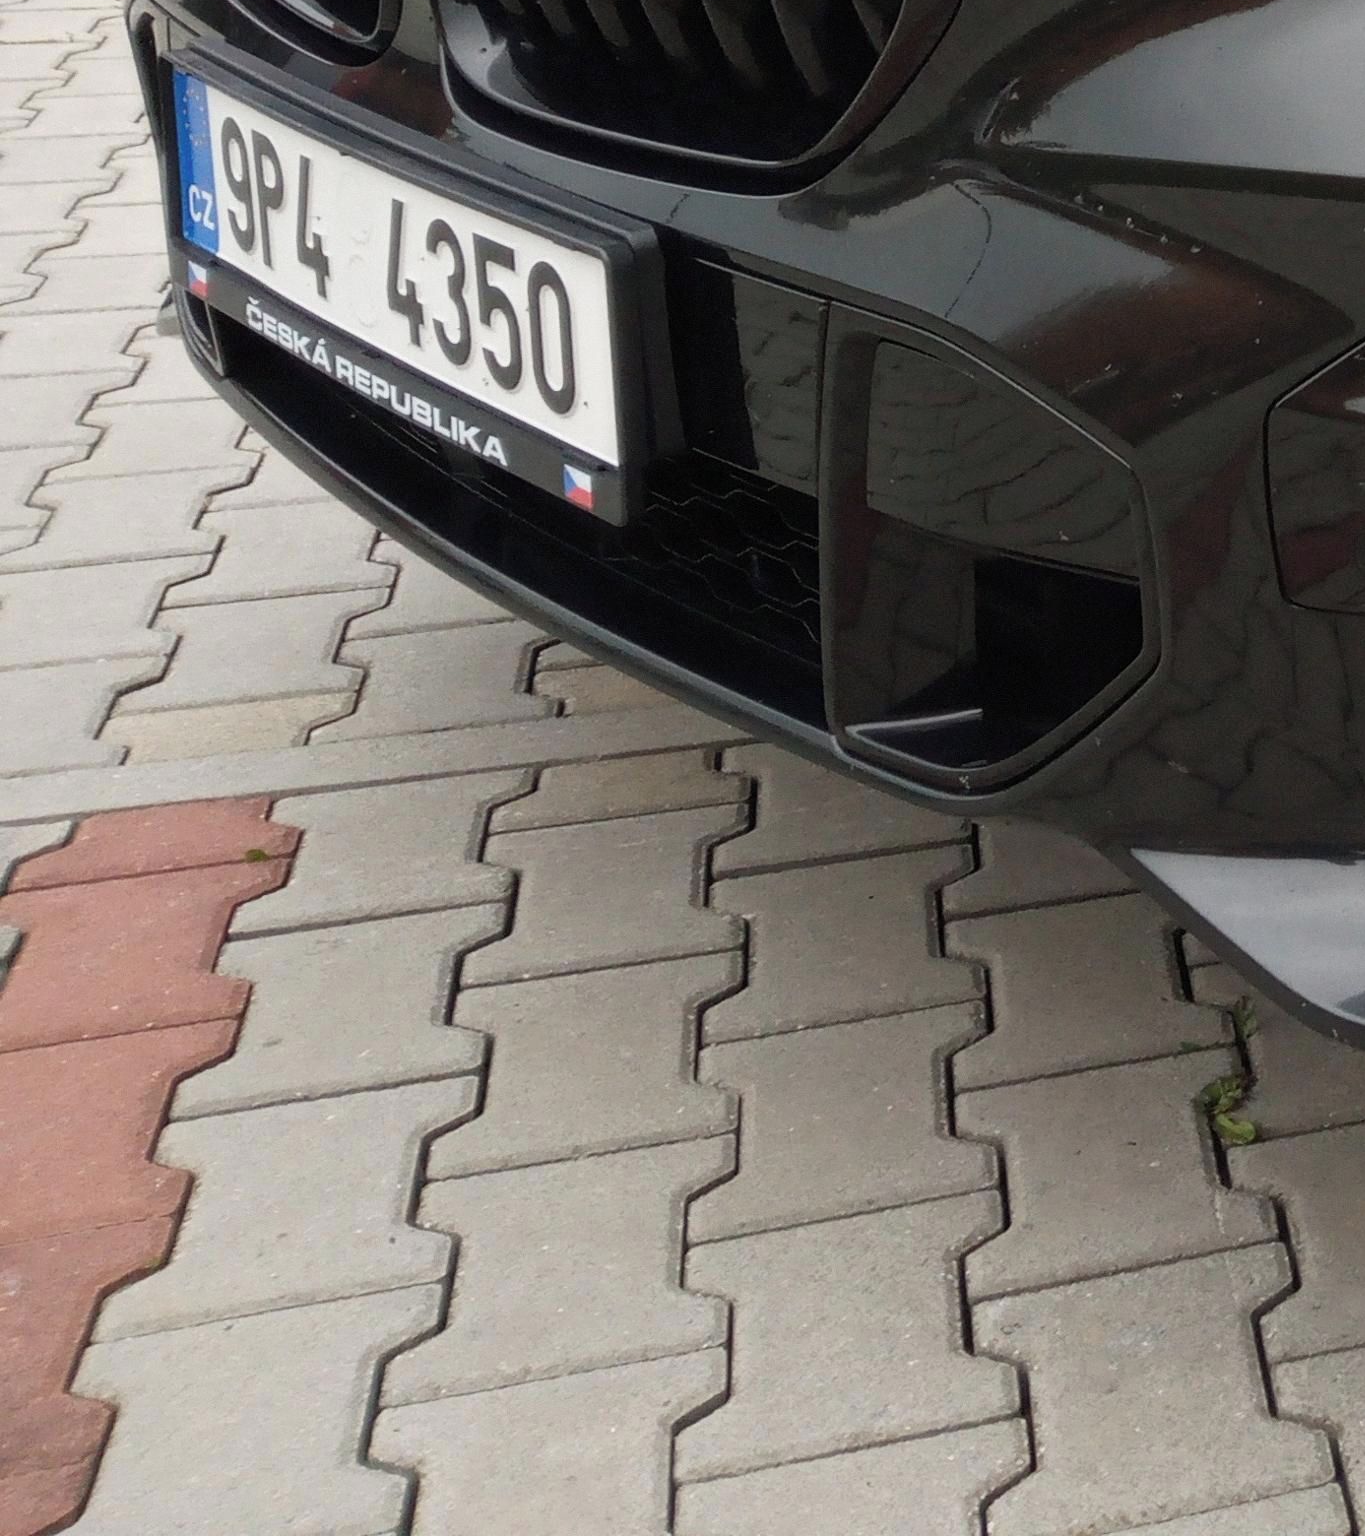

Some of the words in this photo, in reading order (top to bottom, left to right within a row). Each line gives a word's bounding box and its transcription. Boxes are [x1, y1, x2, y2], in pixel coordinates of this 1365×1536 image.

[188, 184, 215, 231] CZ
[220, 116, 330, 300] 9P4
[387, 197, 576, 415] 4350
[247, 296, 334, 371] ČESKÁ
[335, 356, 509, 467] REPUBLIKA
